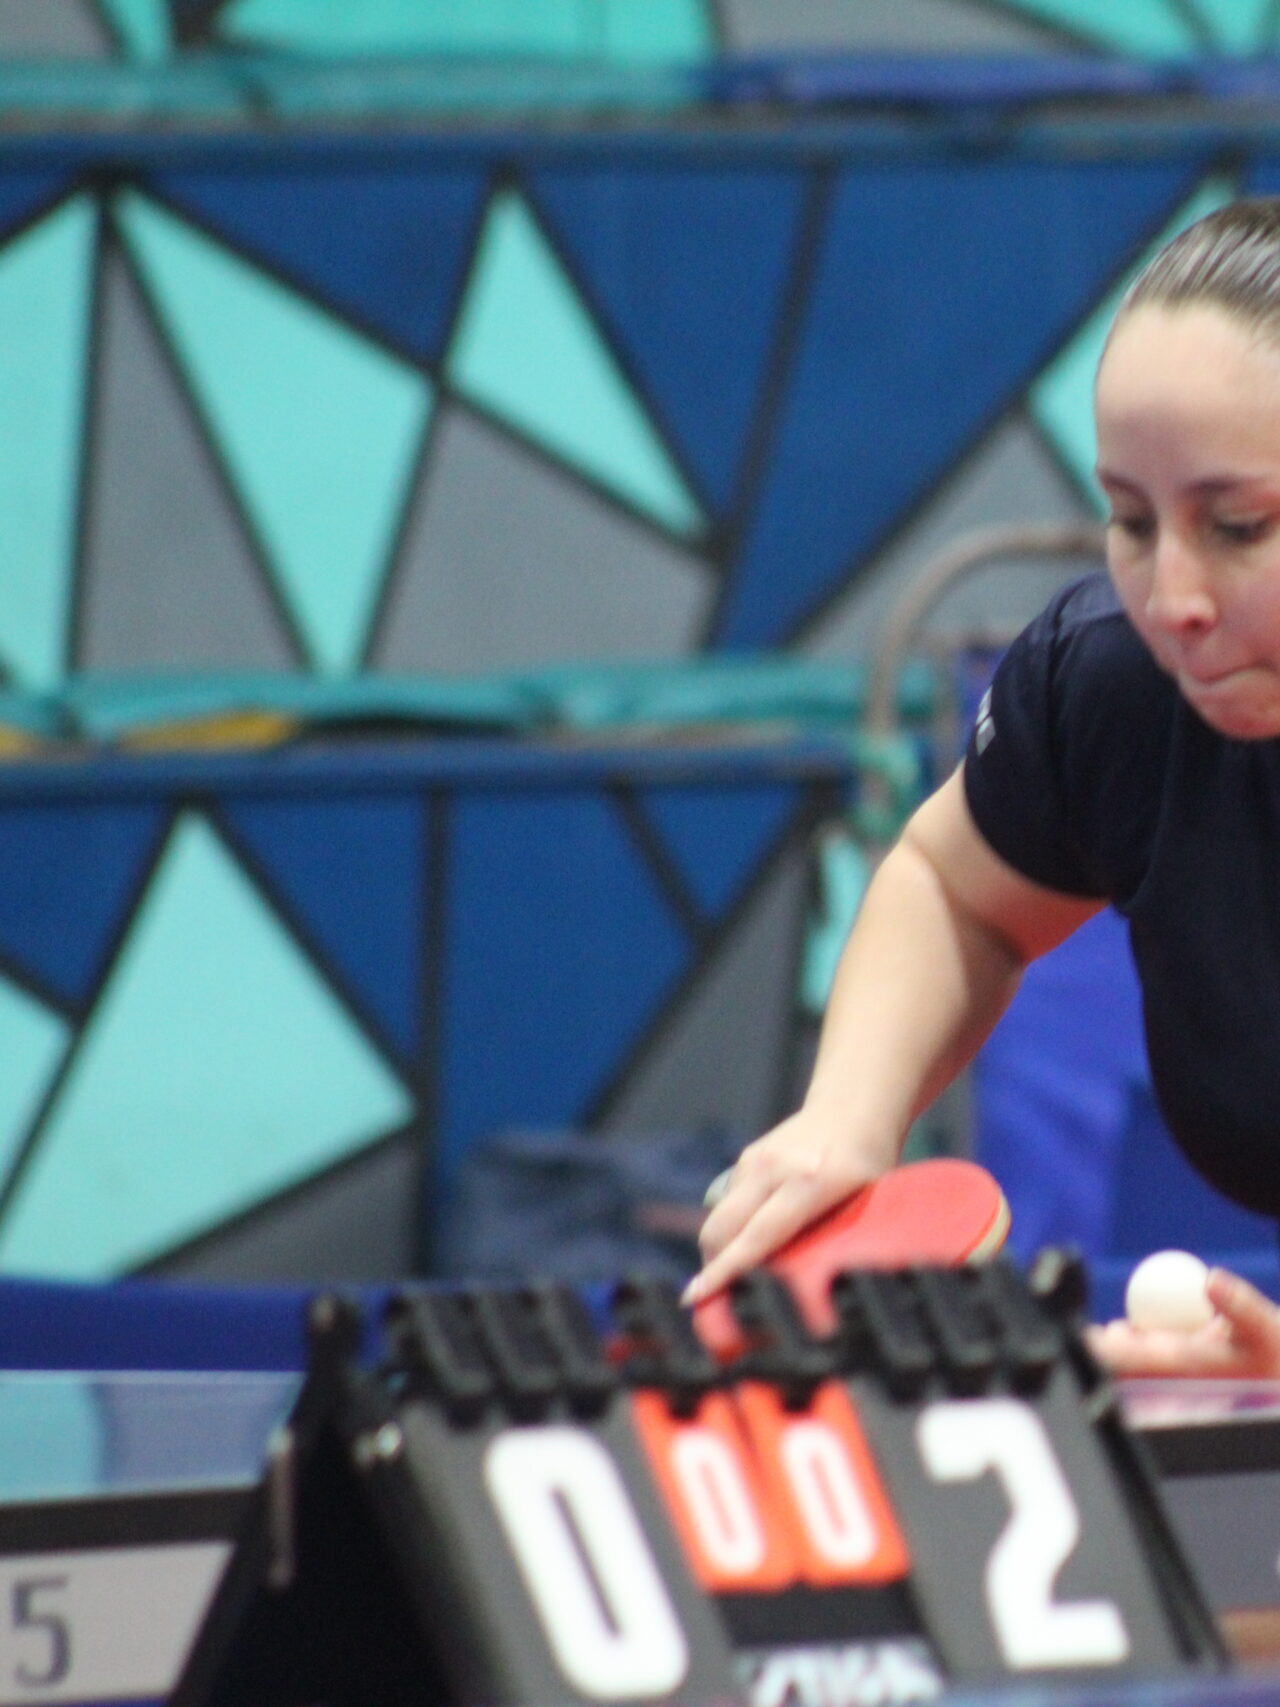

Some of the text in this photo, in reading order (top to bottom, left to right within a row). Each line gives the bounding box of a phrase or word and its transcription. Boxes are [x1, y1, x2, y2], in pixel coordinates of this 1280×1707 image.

[12, 1573, 72, 1688] 5
[484, 1400, 1130, 1699] 0 0 0 2
